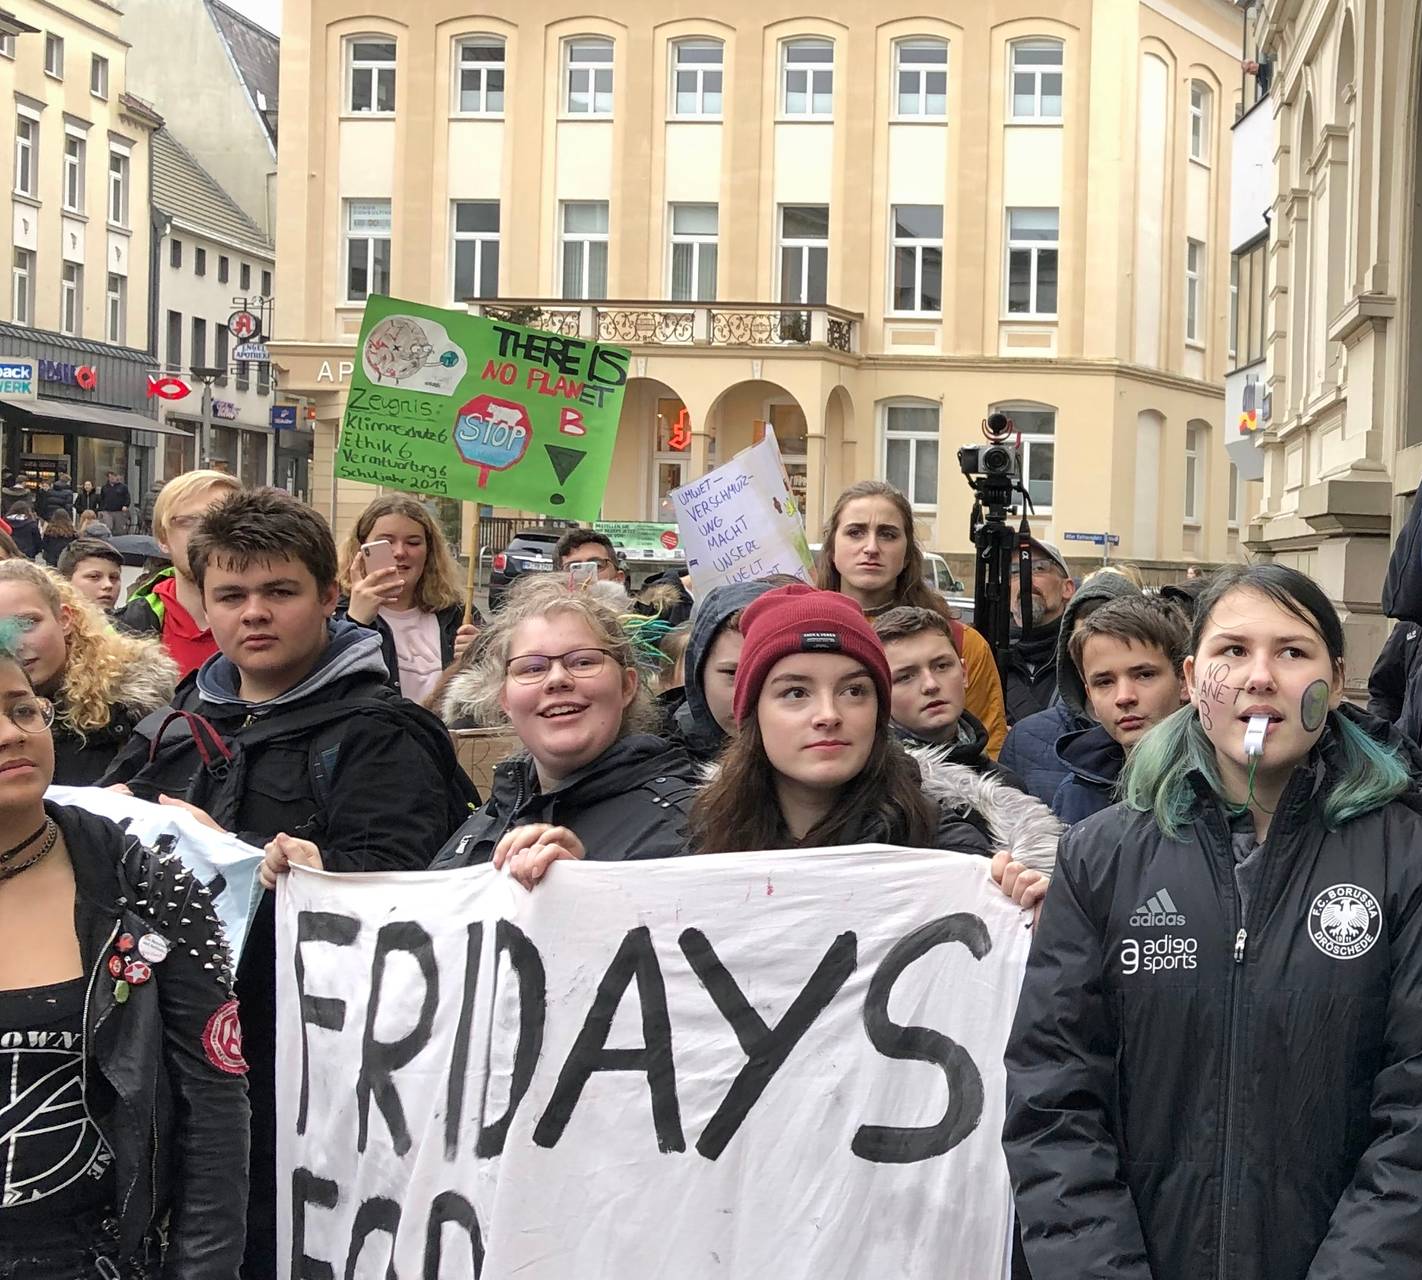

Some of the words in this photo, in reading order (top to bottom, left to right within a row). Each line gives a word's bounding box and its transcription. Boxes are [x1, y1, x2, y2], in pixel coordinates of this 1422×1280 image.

[493, 325, 586, 376] THERE
[587, 345, 628, 386] IS
[481, 360, 518, 386] NO
[526, 367, 614, 408] PLANET
[459, 413, 527, 451] STOP
[559, 408, 587, 436] B
[344, 432, 393, 454] Ethik
[398, 441, 413, 460] 6
[340, 465, 407, 484] Schuljahr
[409, 476, 448, 495] 2019
[439, 465, 447, 477] 6
[698, 516, 724, 537] UNG
[707, 514, 749, 551] MACHT
[712, 540, 761, 573] UNSERE
[1205, 662, 1231, 683] NO
[1199, 699, 1213, 731] B
[1327, 887, 1378, 919] BORUSSIA
[1129, 911, 1186, 927] adidas
[1313, 930, 1375, 956] DRÖSCHEDE
[1143, 952, 1198, 974] sports
[294, 910, 993, 1163] FRIDAYS
